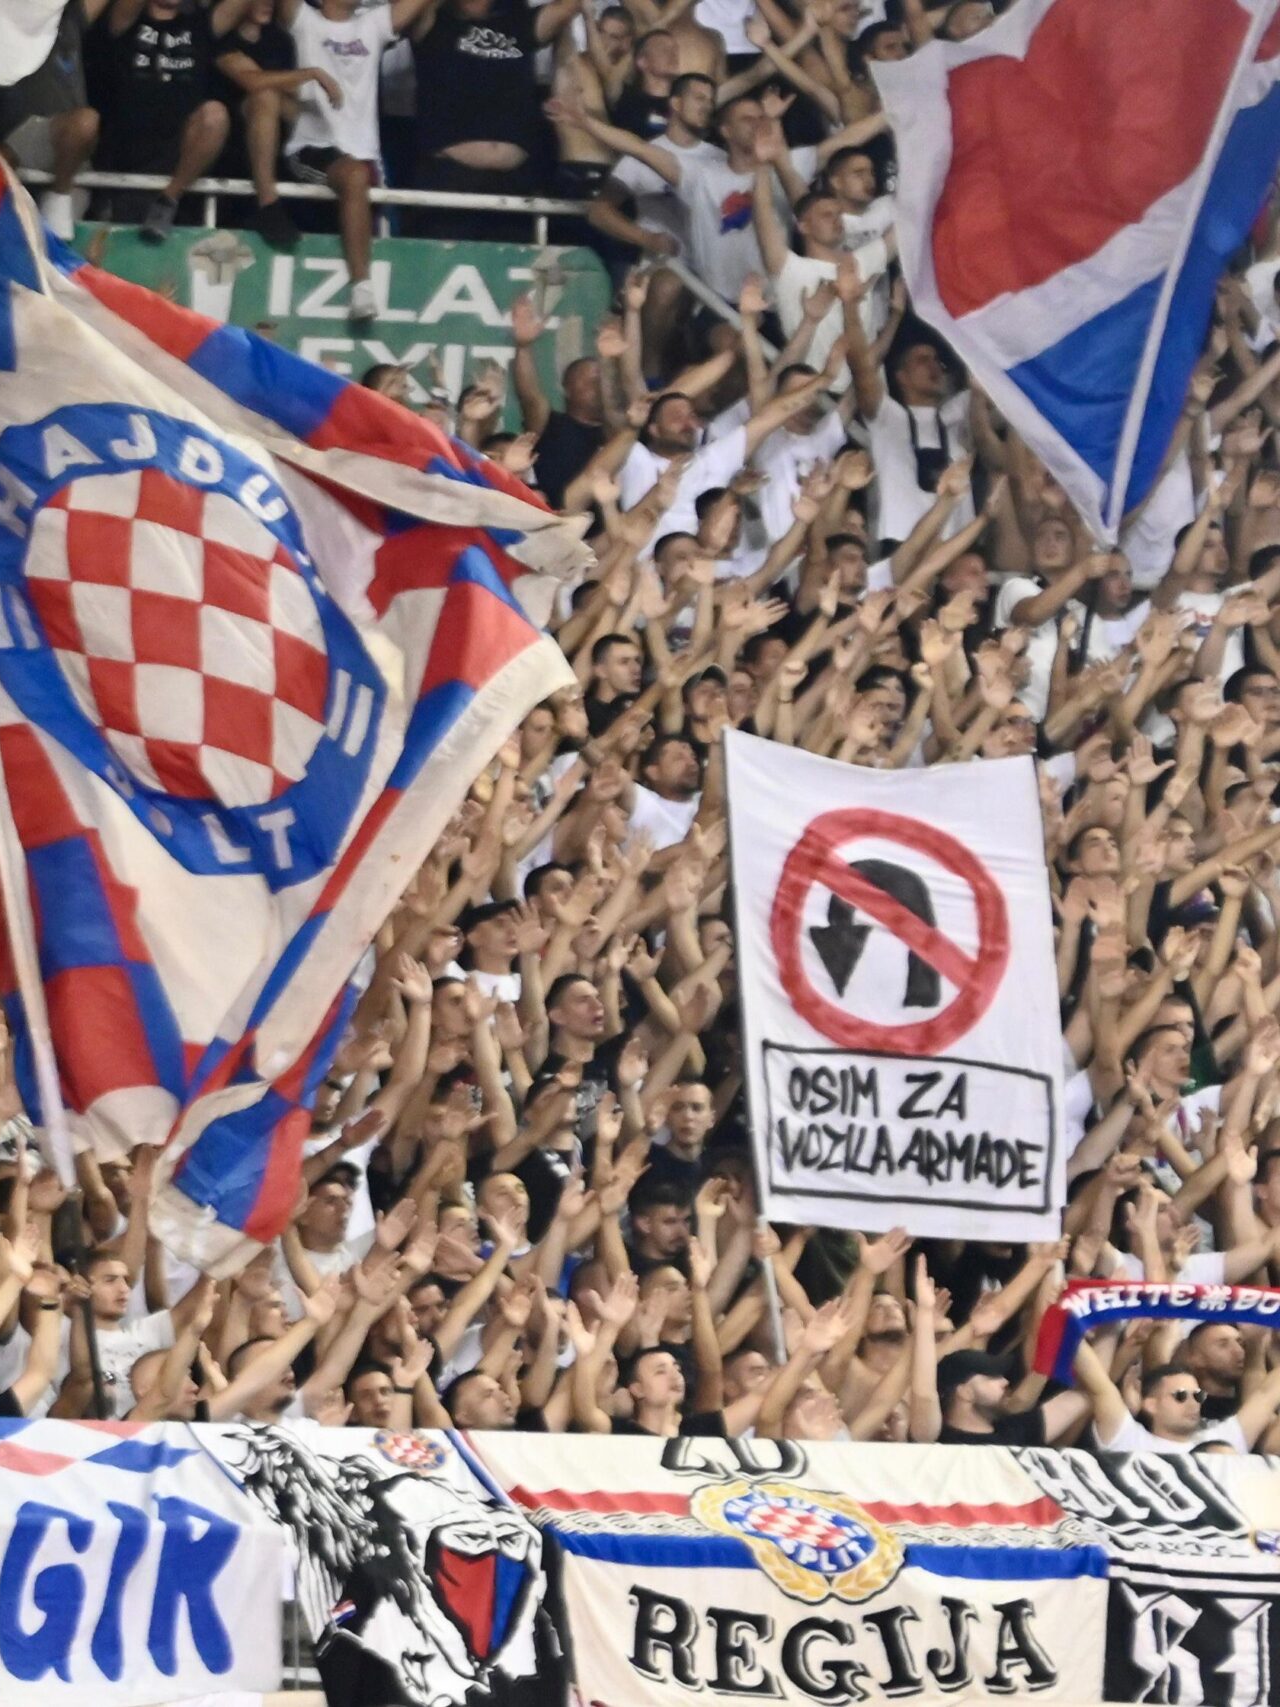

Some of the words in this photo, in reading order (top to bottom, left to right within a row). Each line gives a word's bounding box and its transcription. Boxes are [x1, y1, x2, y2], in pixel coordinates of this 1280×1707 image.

[788, 1064, 880, 1118] OSIM
[897, 1071, 967, 1121] ZA
[777, 1116, 896, 1176] VOZILA
[897, 1127, 1044, 1188] ARMADE
[1061, 1283, 1197, 1319] WHITE
[778, 1537, 868, 1572] SPLIT
[628, 1584, 1060, 1707] REGIJA
